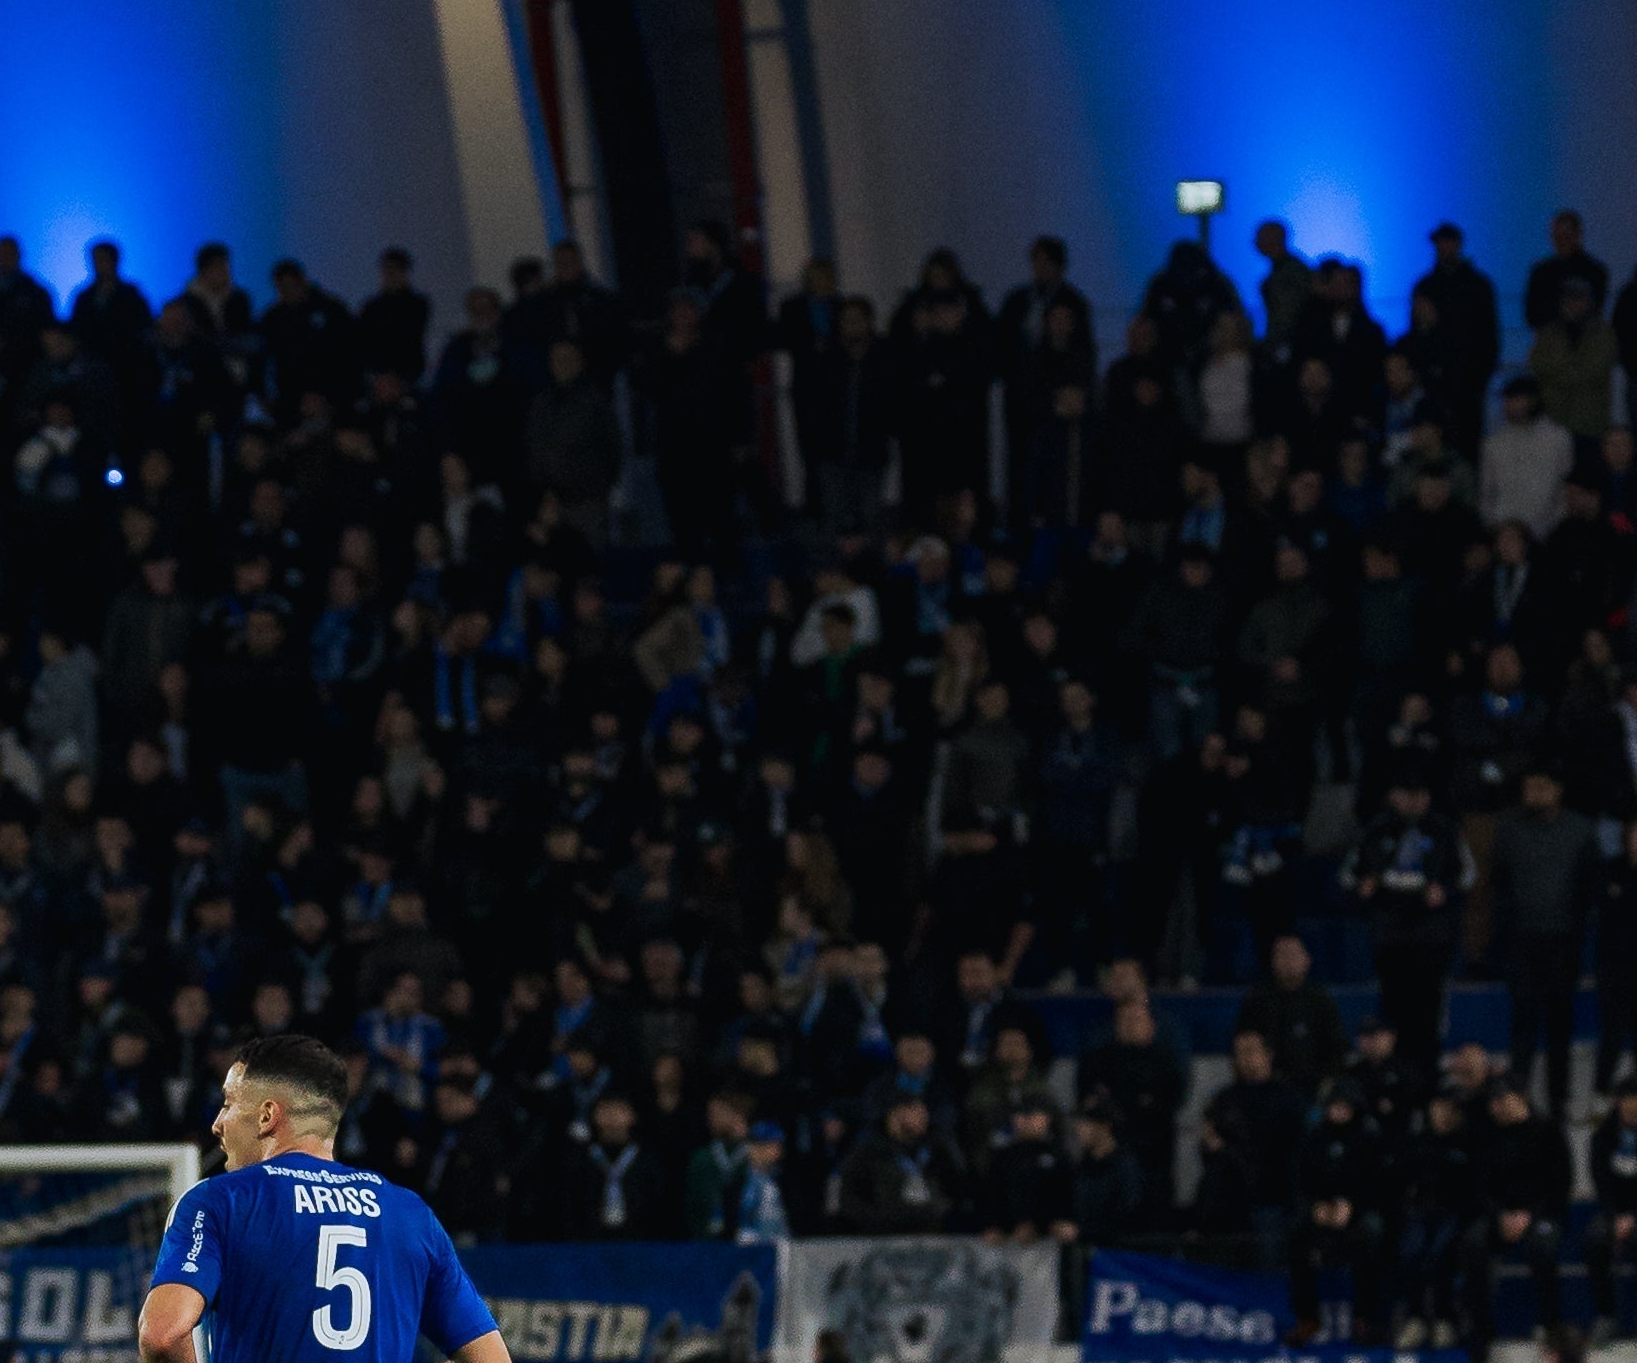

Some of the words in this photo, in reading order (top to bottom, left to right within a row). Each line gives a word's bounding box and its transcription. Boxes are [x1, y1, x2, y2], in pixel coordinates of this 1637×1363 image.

[294, 1184, 381, 1217] ARISS
[312, 1224, 372, 1350] 5
[1090, 1279, 1276, 1345] Paese
[486, 1298, 650, 1361] ASTIA
